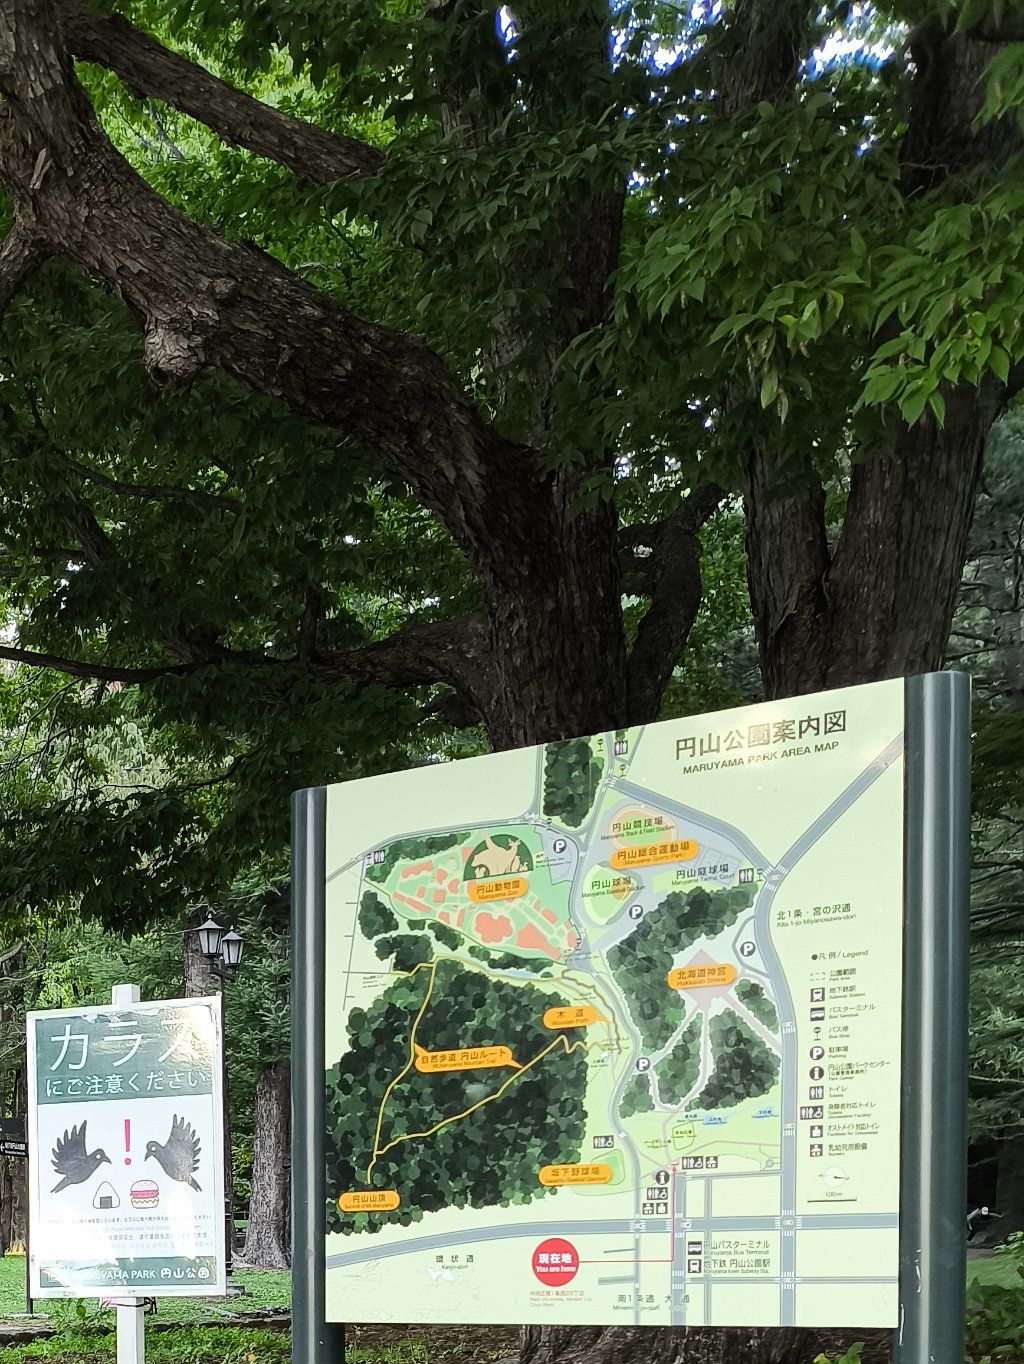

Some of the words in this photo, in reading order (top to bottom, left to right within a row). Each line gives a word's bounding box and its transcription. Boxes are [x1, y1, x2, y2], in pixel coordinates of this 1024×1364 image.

[676, 710, 847, 760] 円山公園案内図
[683, 757, 745, 774] MARUYAMA
[748, 751, 778, 764] PARK
[781, 746, 811, 758] AREA
[814, 741, 839, 753] MAP
[617, 841, 690, 861] 円山総合運動場
[677, 863, 729, 879] 円山庭球場
[477, 880, 521, 895] 円山動物園
[592, 876, 632, 890] 円山球場
[677, 966, 726, 980] 北海道神宮
[47, 1070, 204, 1097] にご注意ください
[538, 1253, 572, 1264] 現在地
[131, 1269, 156, 1280] PARK
[160, 1266, 210, 1280] 円山公園
[535, 1265, 548, 1273] You
[561, 1265, 576, 1273] here
